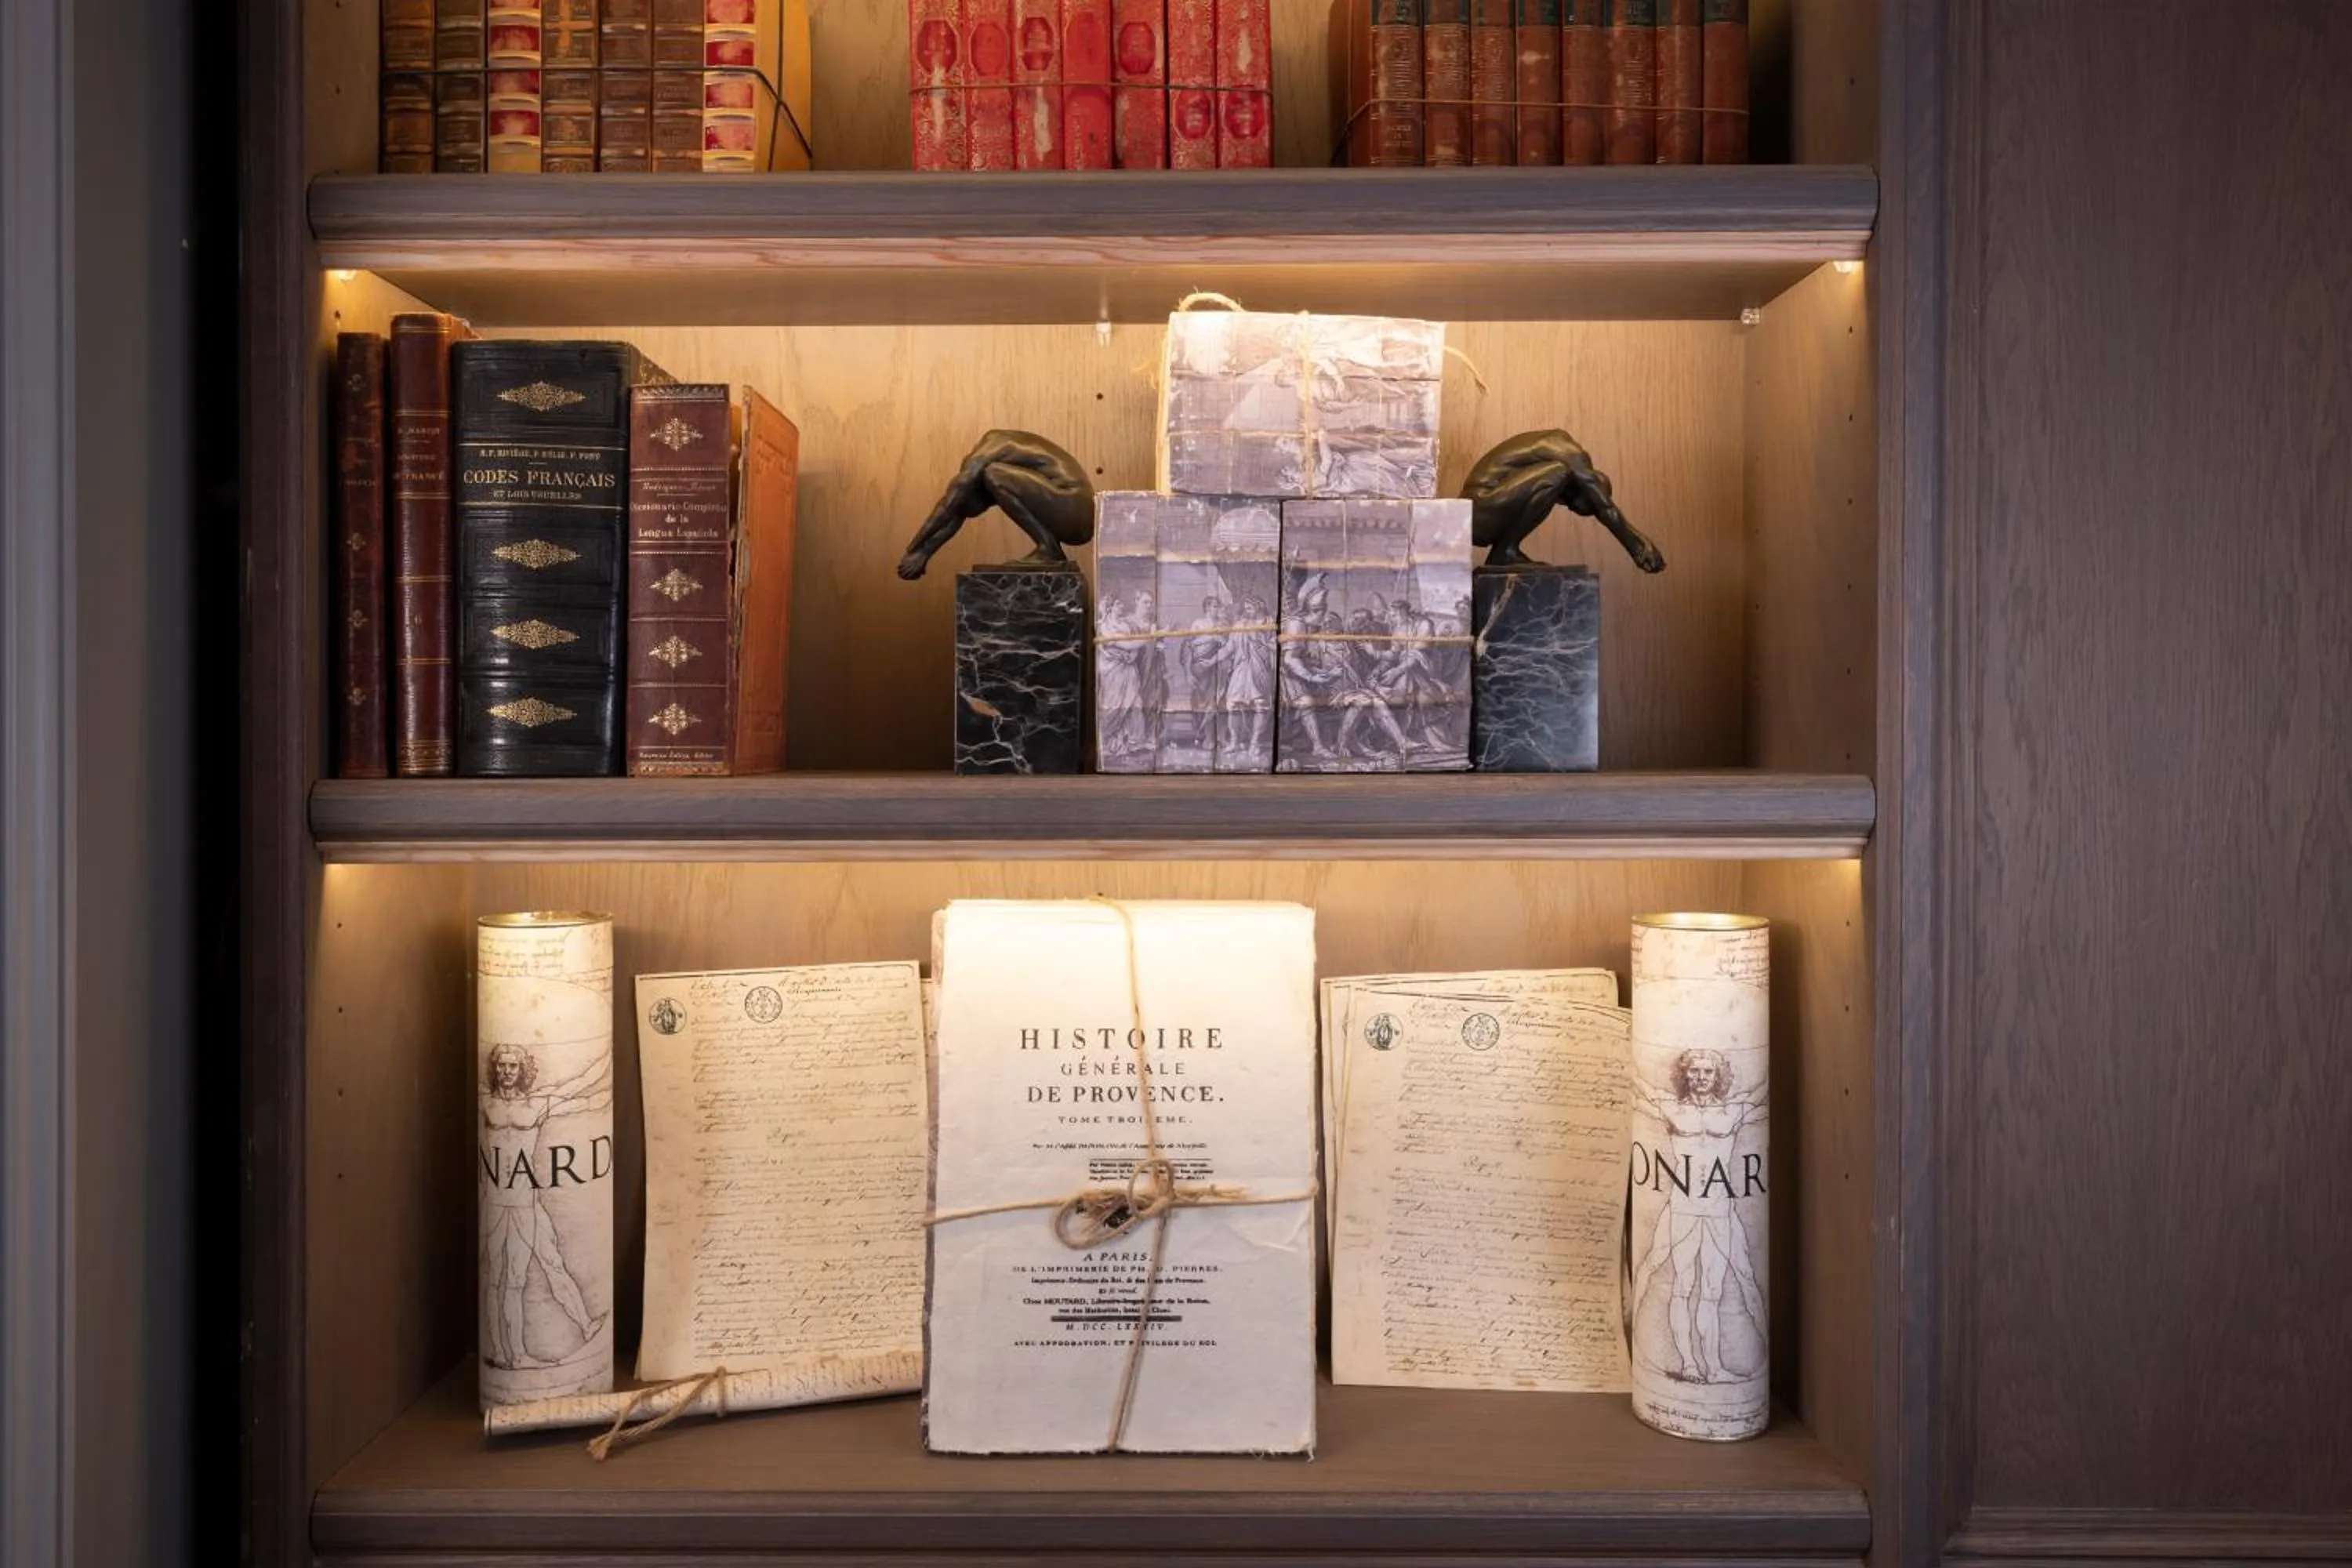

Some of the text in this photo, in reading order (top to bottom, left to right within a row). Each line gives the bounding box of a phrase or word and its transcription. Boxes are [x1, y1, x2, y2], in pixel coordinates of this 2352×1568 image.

[463, 470, 615, 489] CODES FRANÇAIS
[1019, 1028, 1224, 1050] HISTOIRE
[1060, 1054, 1186, 1076] GÉNÉRALE
[1028, 1086, 1225, 1103] DE PROVENCE.
[1058, 1115, 1101, 1124] TOME
[479, 1134, 613, 1190] NARD
[1083, 1251, 1154, 1262] A PARIS.
